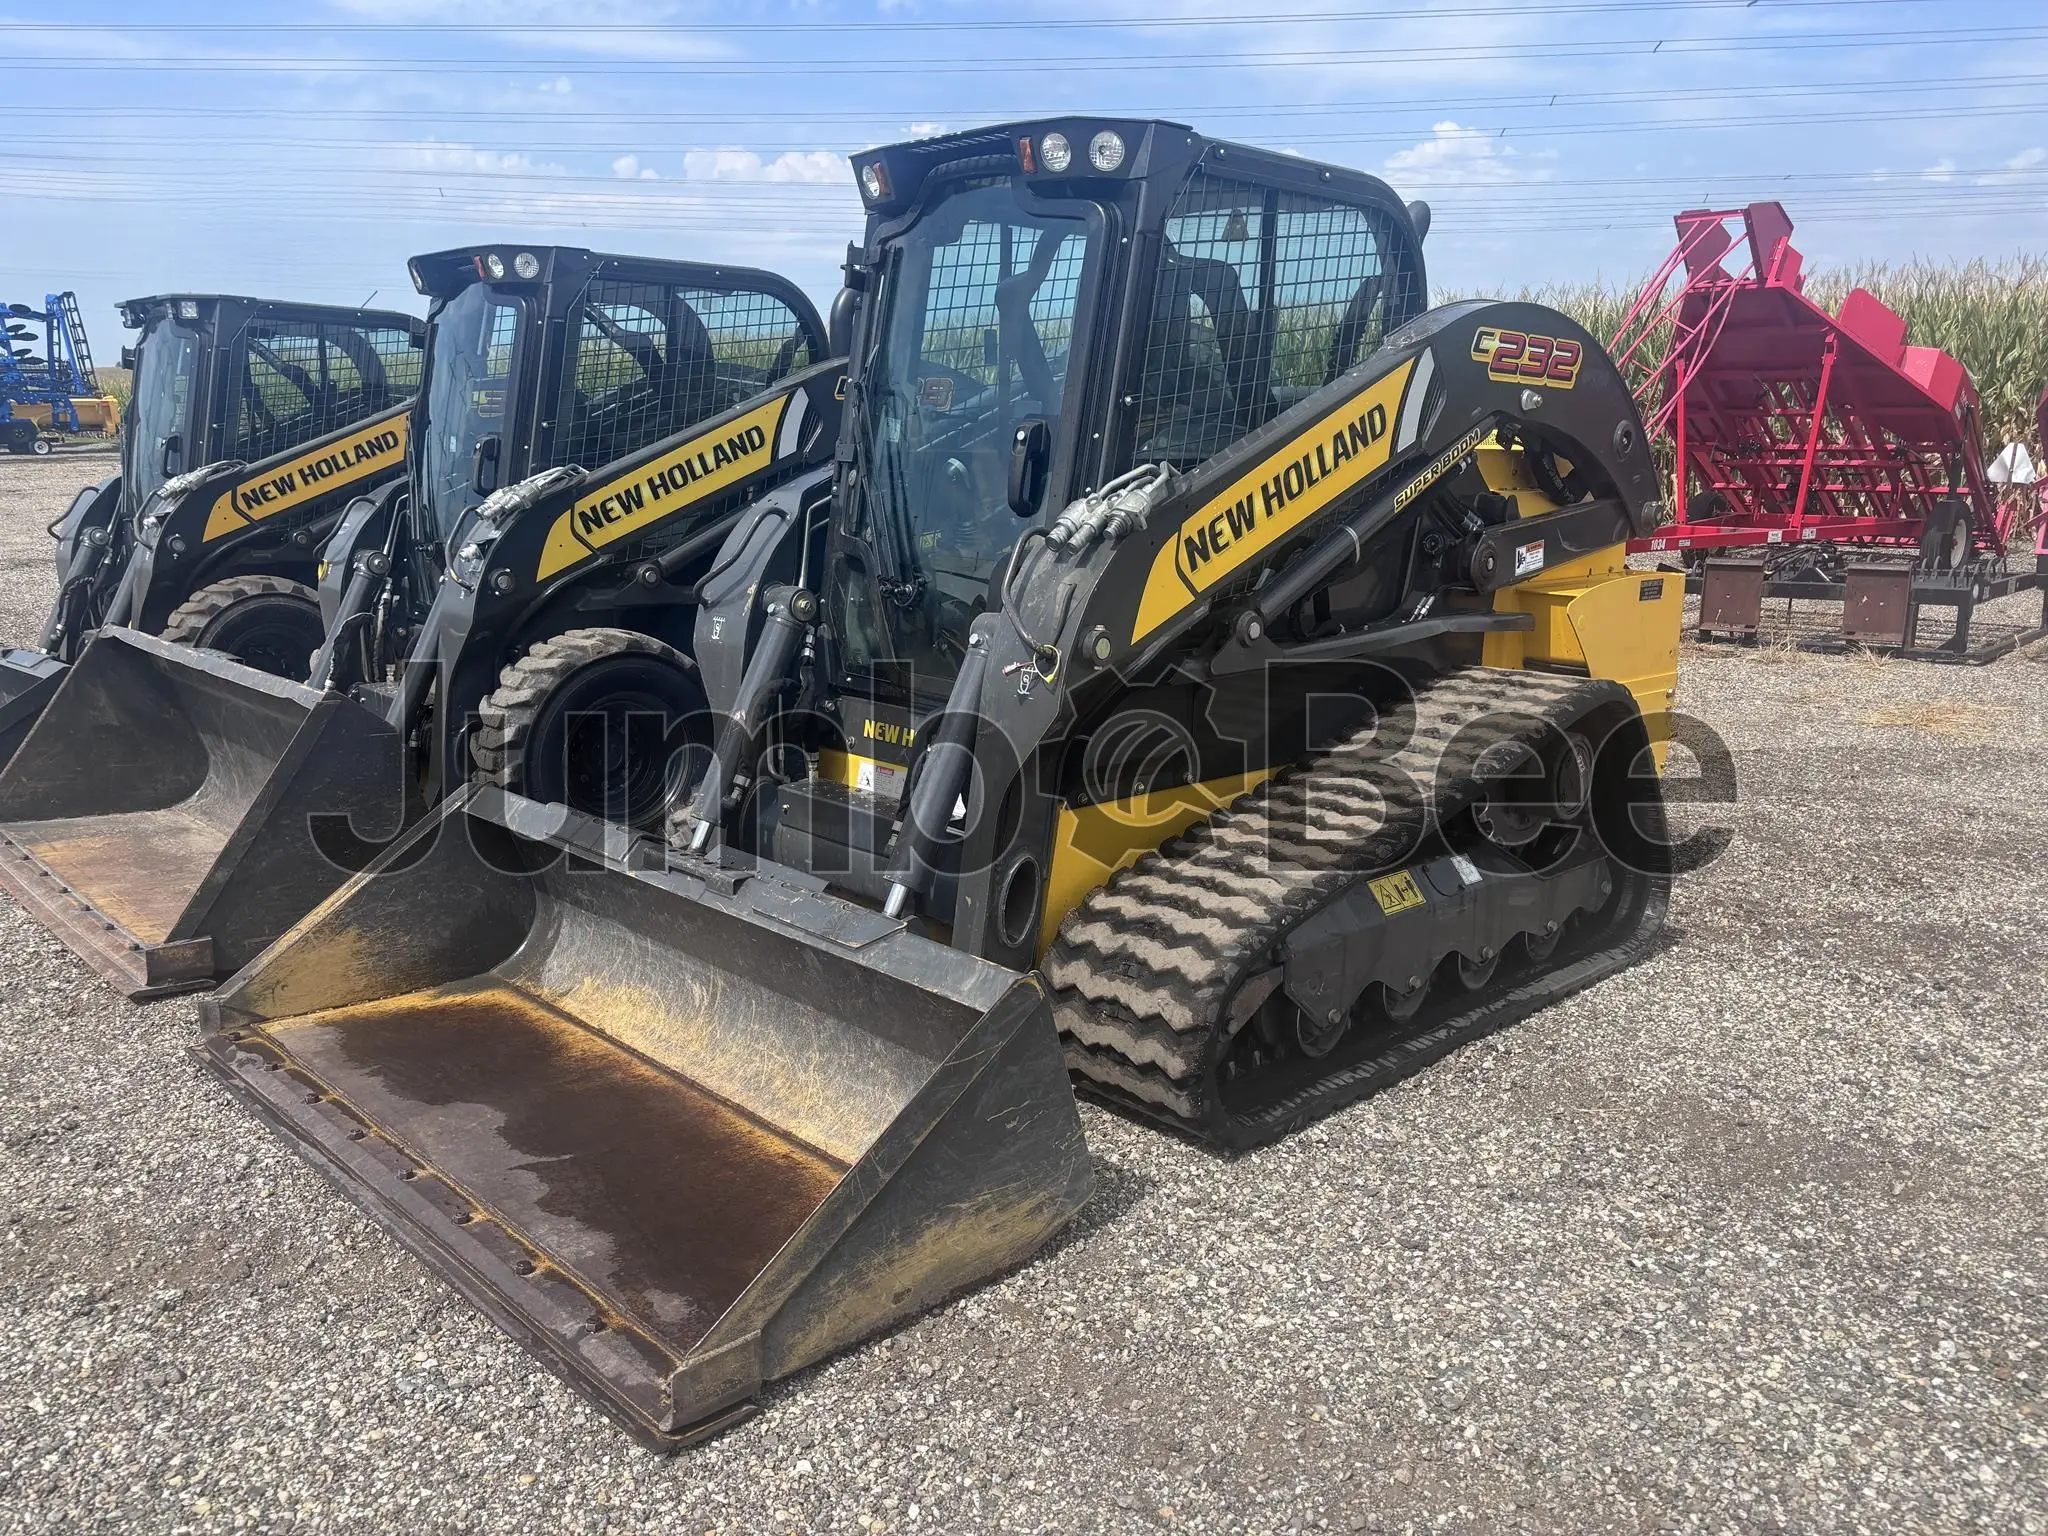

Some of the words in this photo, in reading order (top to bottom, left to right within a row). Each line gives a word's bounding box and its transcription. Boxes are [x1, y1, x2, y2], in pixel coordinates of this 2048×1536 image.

[1471, 327, 1583, 389] C232
[240, 472, 297, 511] NEW
[297, 430, 399, 487] HOLLAND
[577, 483, 645, 535] NEW
[646, 425, 766, 501] HOLLAND
[1183, 491, 1256, 574] NEW
[1260, 402, 1387, 519] HOLLAND
[1394, 462, 1441, 513] SUPER
[1441, 427, 1481, 472] BOOM
[1651, 538, 1667, 550] 1034
[863, 719, 900, 744] NEW
